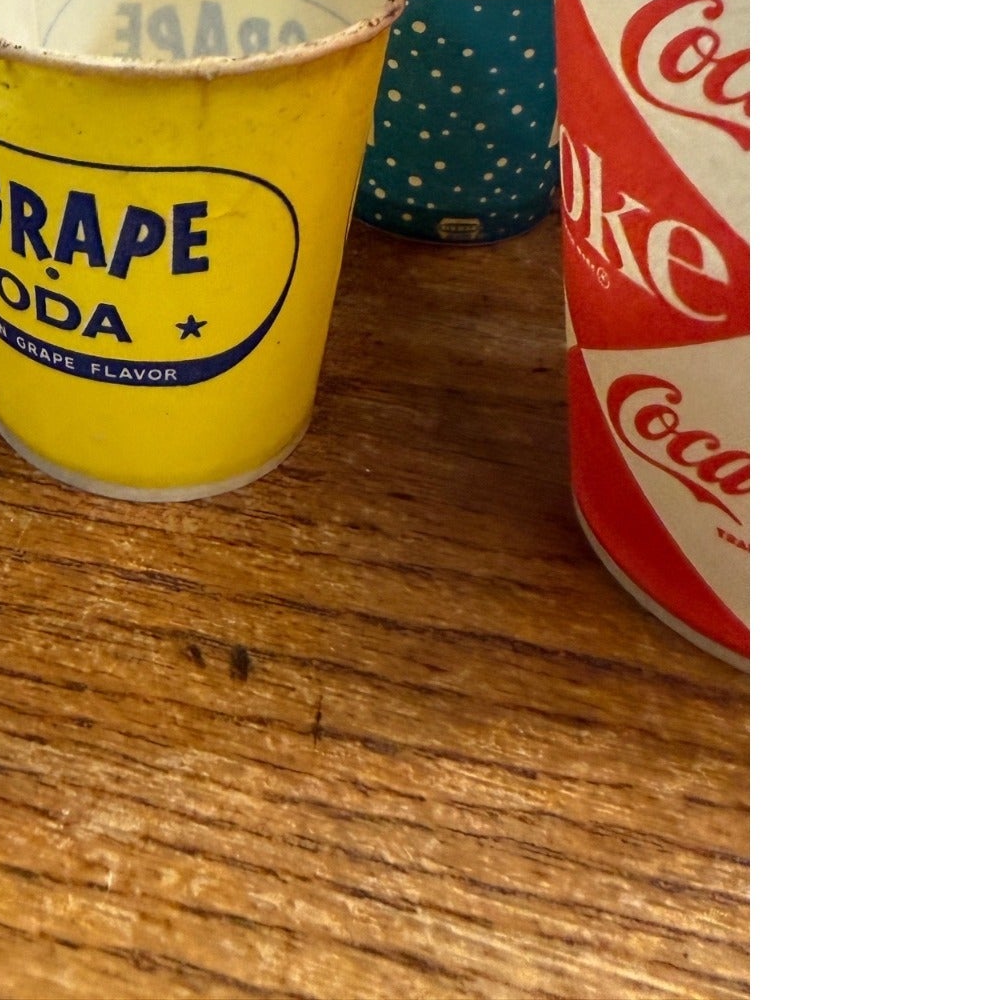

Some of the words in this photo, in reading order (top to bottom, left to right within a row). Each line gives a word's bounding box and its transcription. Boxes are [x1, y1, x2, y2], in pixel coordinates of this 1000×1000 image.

[560, 124, 730, 322] oke
[16, 336, 76, 371] GRAPE
[91, 363, 178, 381] FLAVOR
